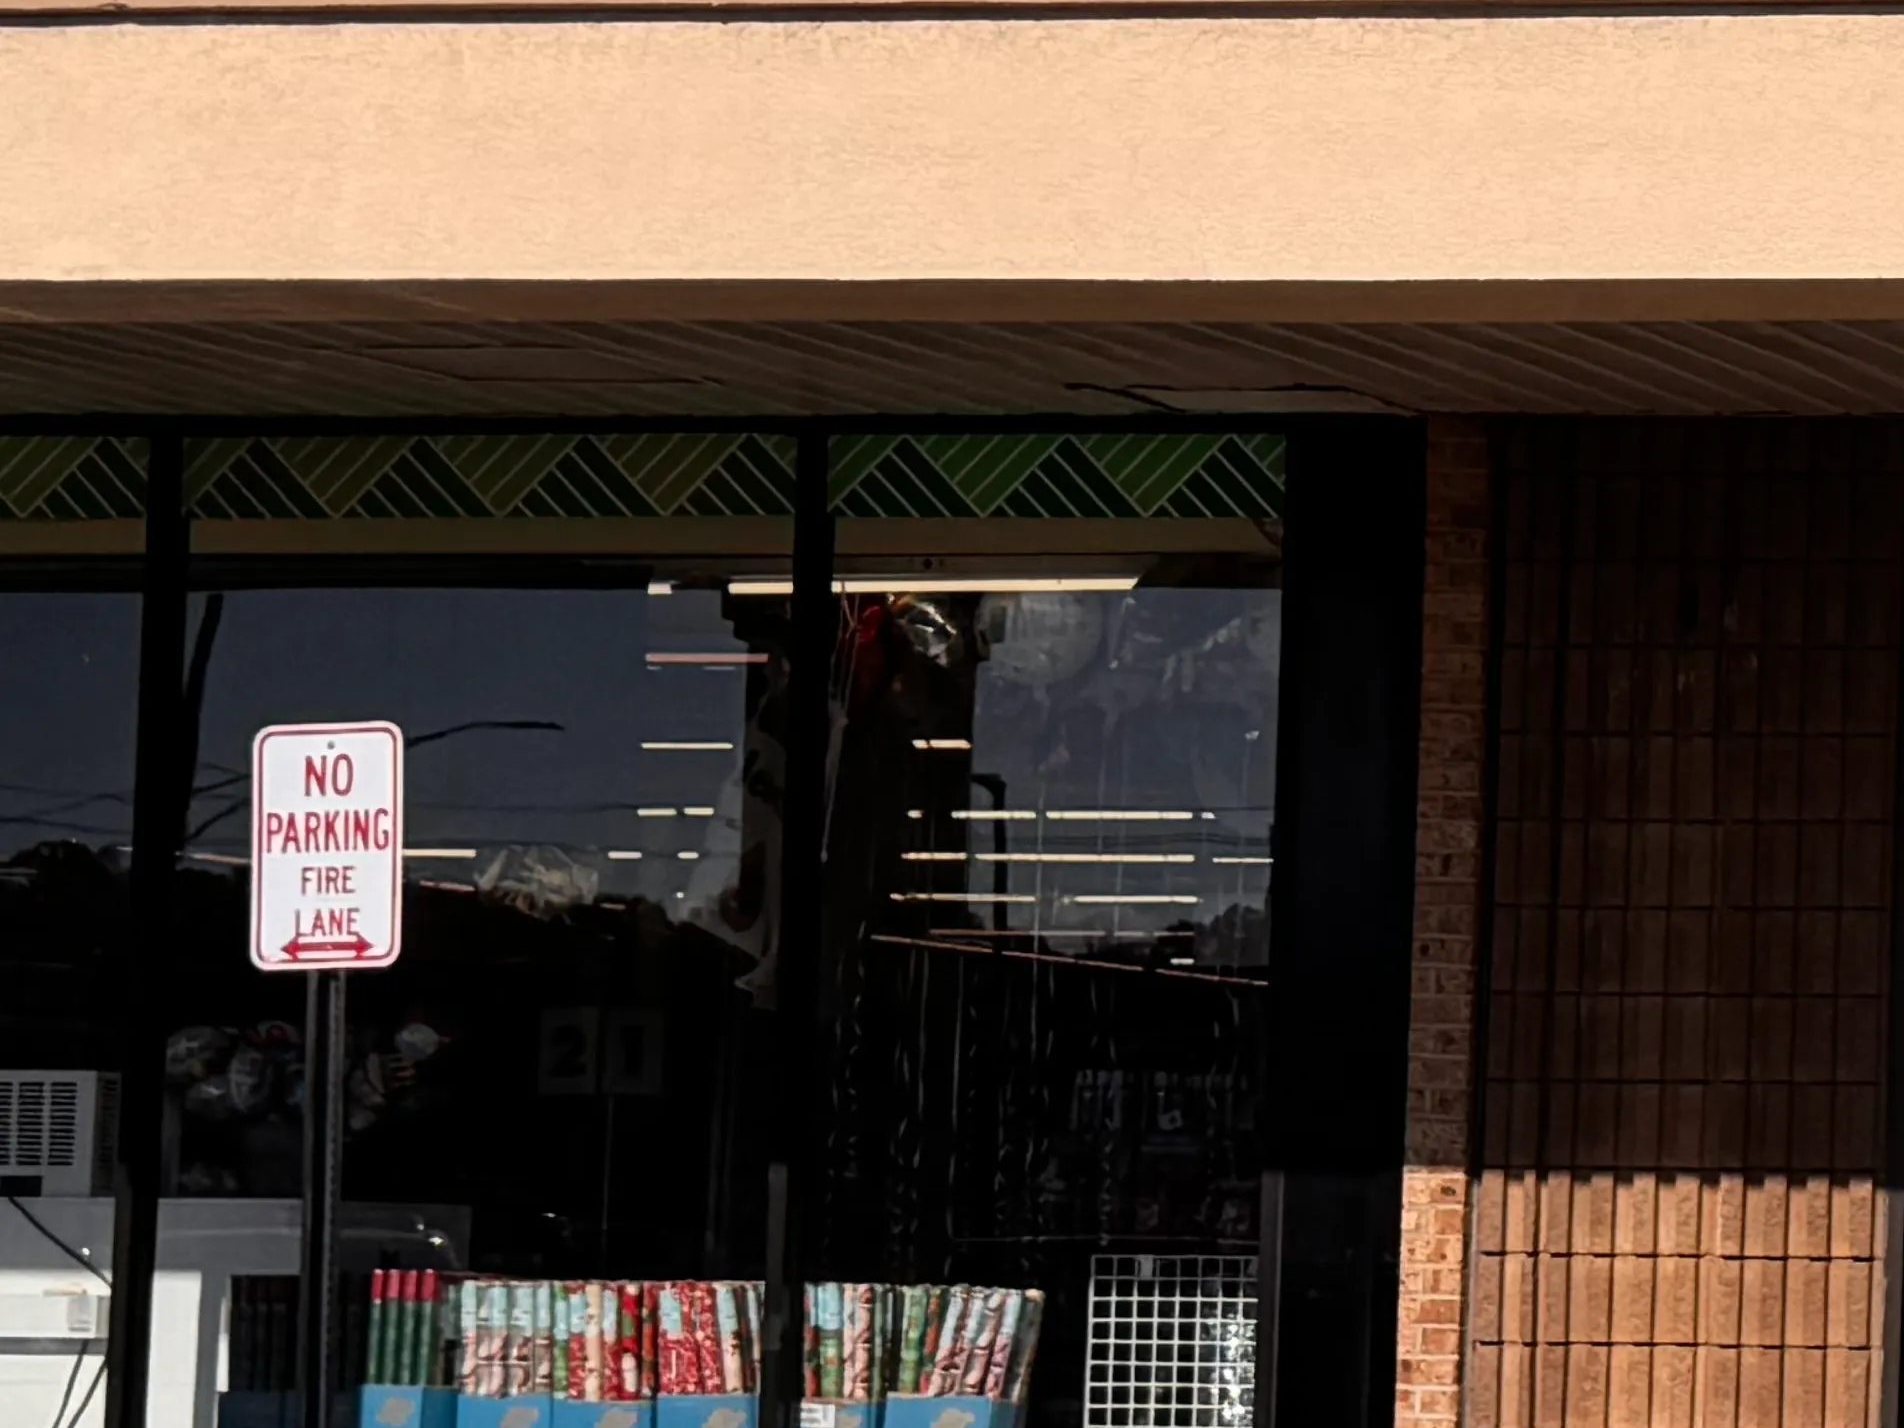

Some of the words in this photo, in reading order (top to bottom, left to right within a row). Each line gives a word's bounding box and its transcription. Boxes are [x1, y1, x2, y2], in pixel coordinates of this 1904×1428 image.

[303, 752, 355, 798] NO
[265, 807, 390, 855] PARKING
[300, 865, 357, 896] FIRE
[294, 907, 360, 938] LANE
